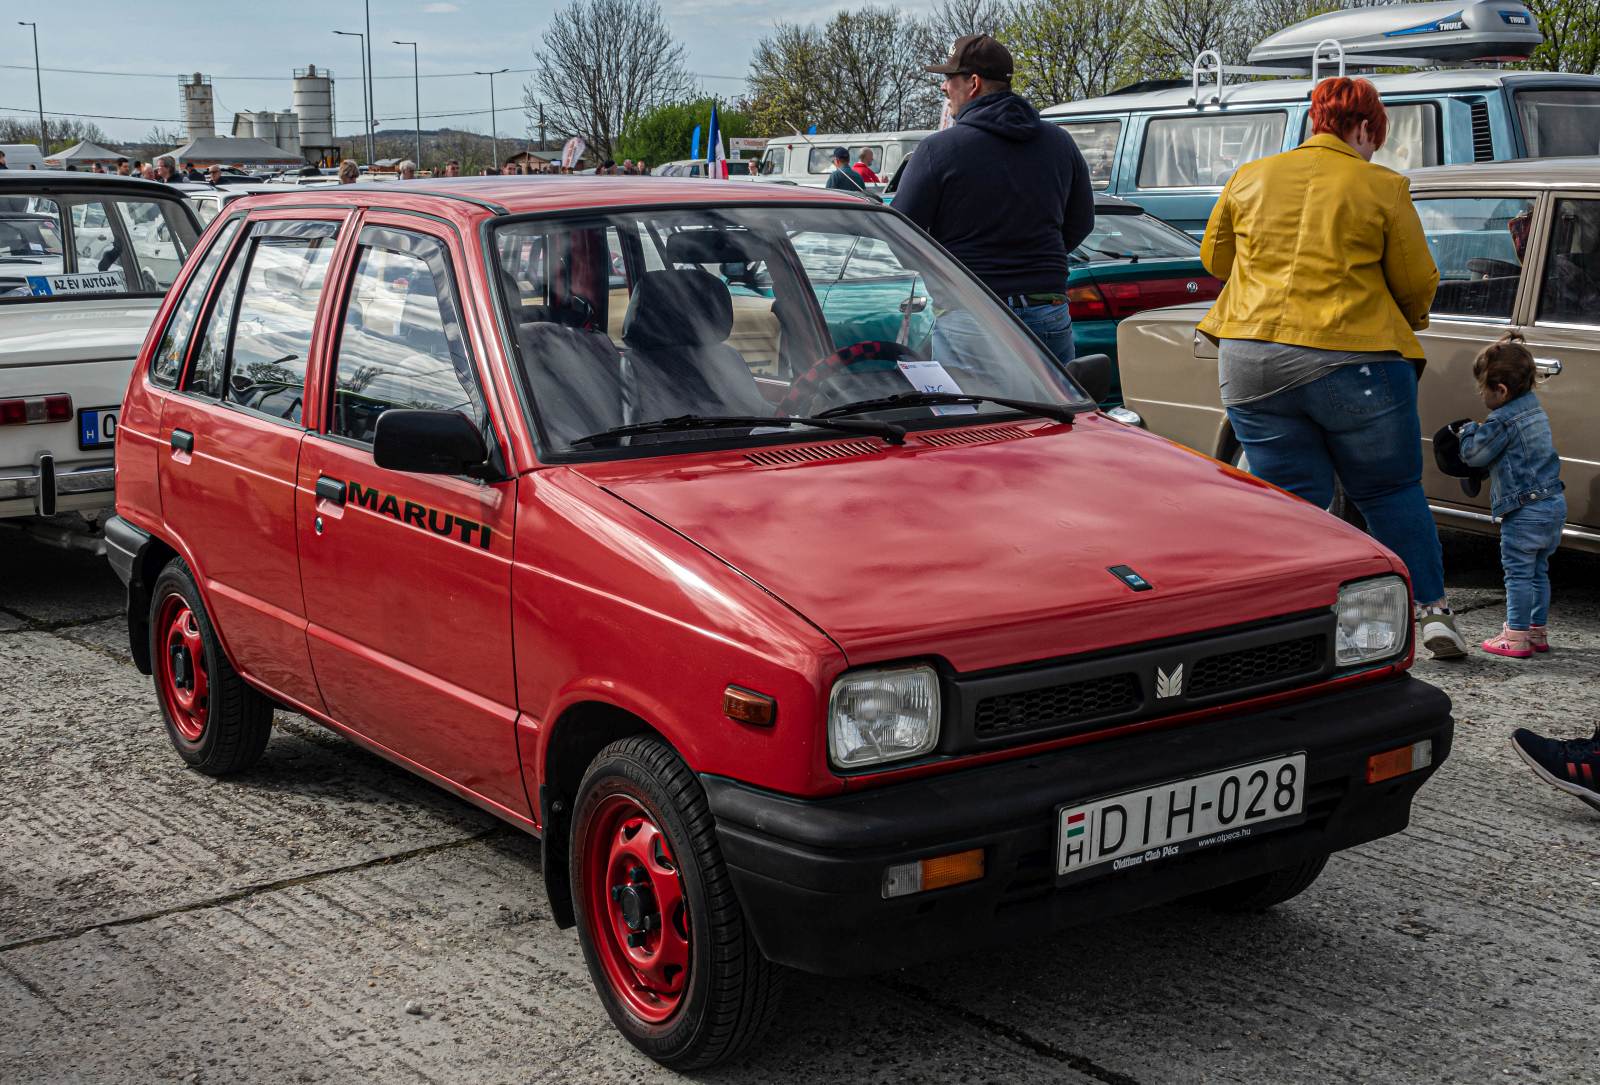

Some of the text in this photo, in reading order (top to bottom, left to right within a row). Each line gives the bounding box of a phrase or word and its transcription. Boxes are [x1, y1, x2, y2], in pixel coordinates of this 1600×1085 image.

[1440, 22, 1462, 31] THULE
[1509, 16, 1525, 24] THULE
[54, 275, 119, 290] AZ ÉV AUTÓJA
[86, 430, 95, 440] H
[348, 481, 492, 550] MARUTI
[1098, 763, 1297, 857] DIH-028
[1065, 840, 1084, 867] H
